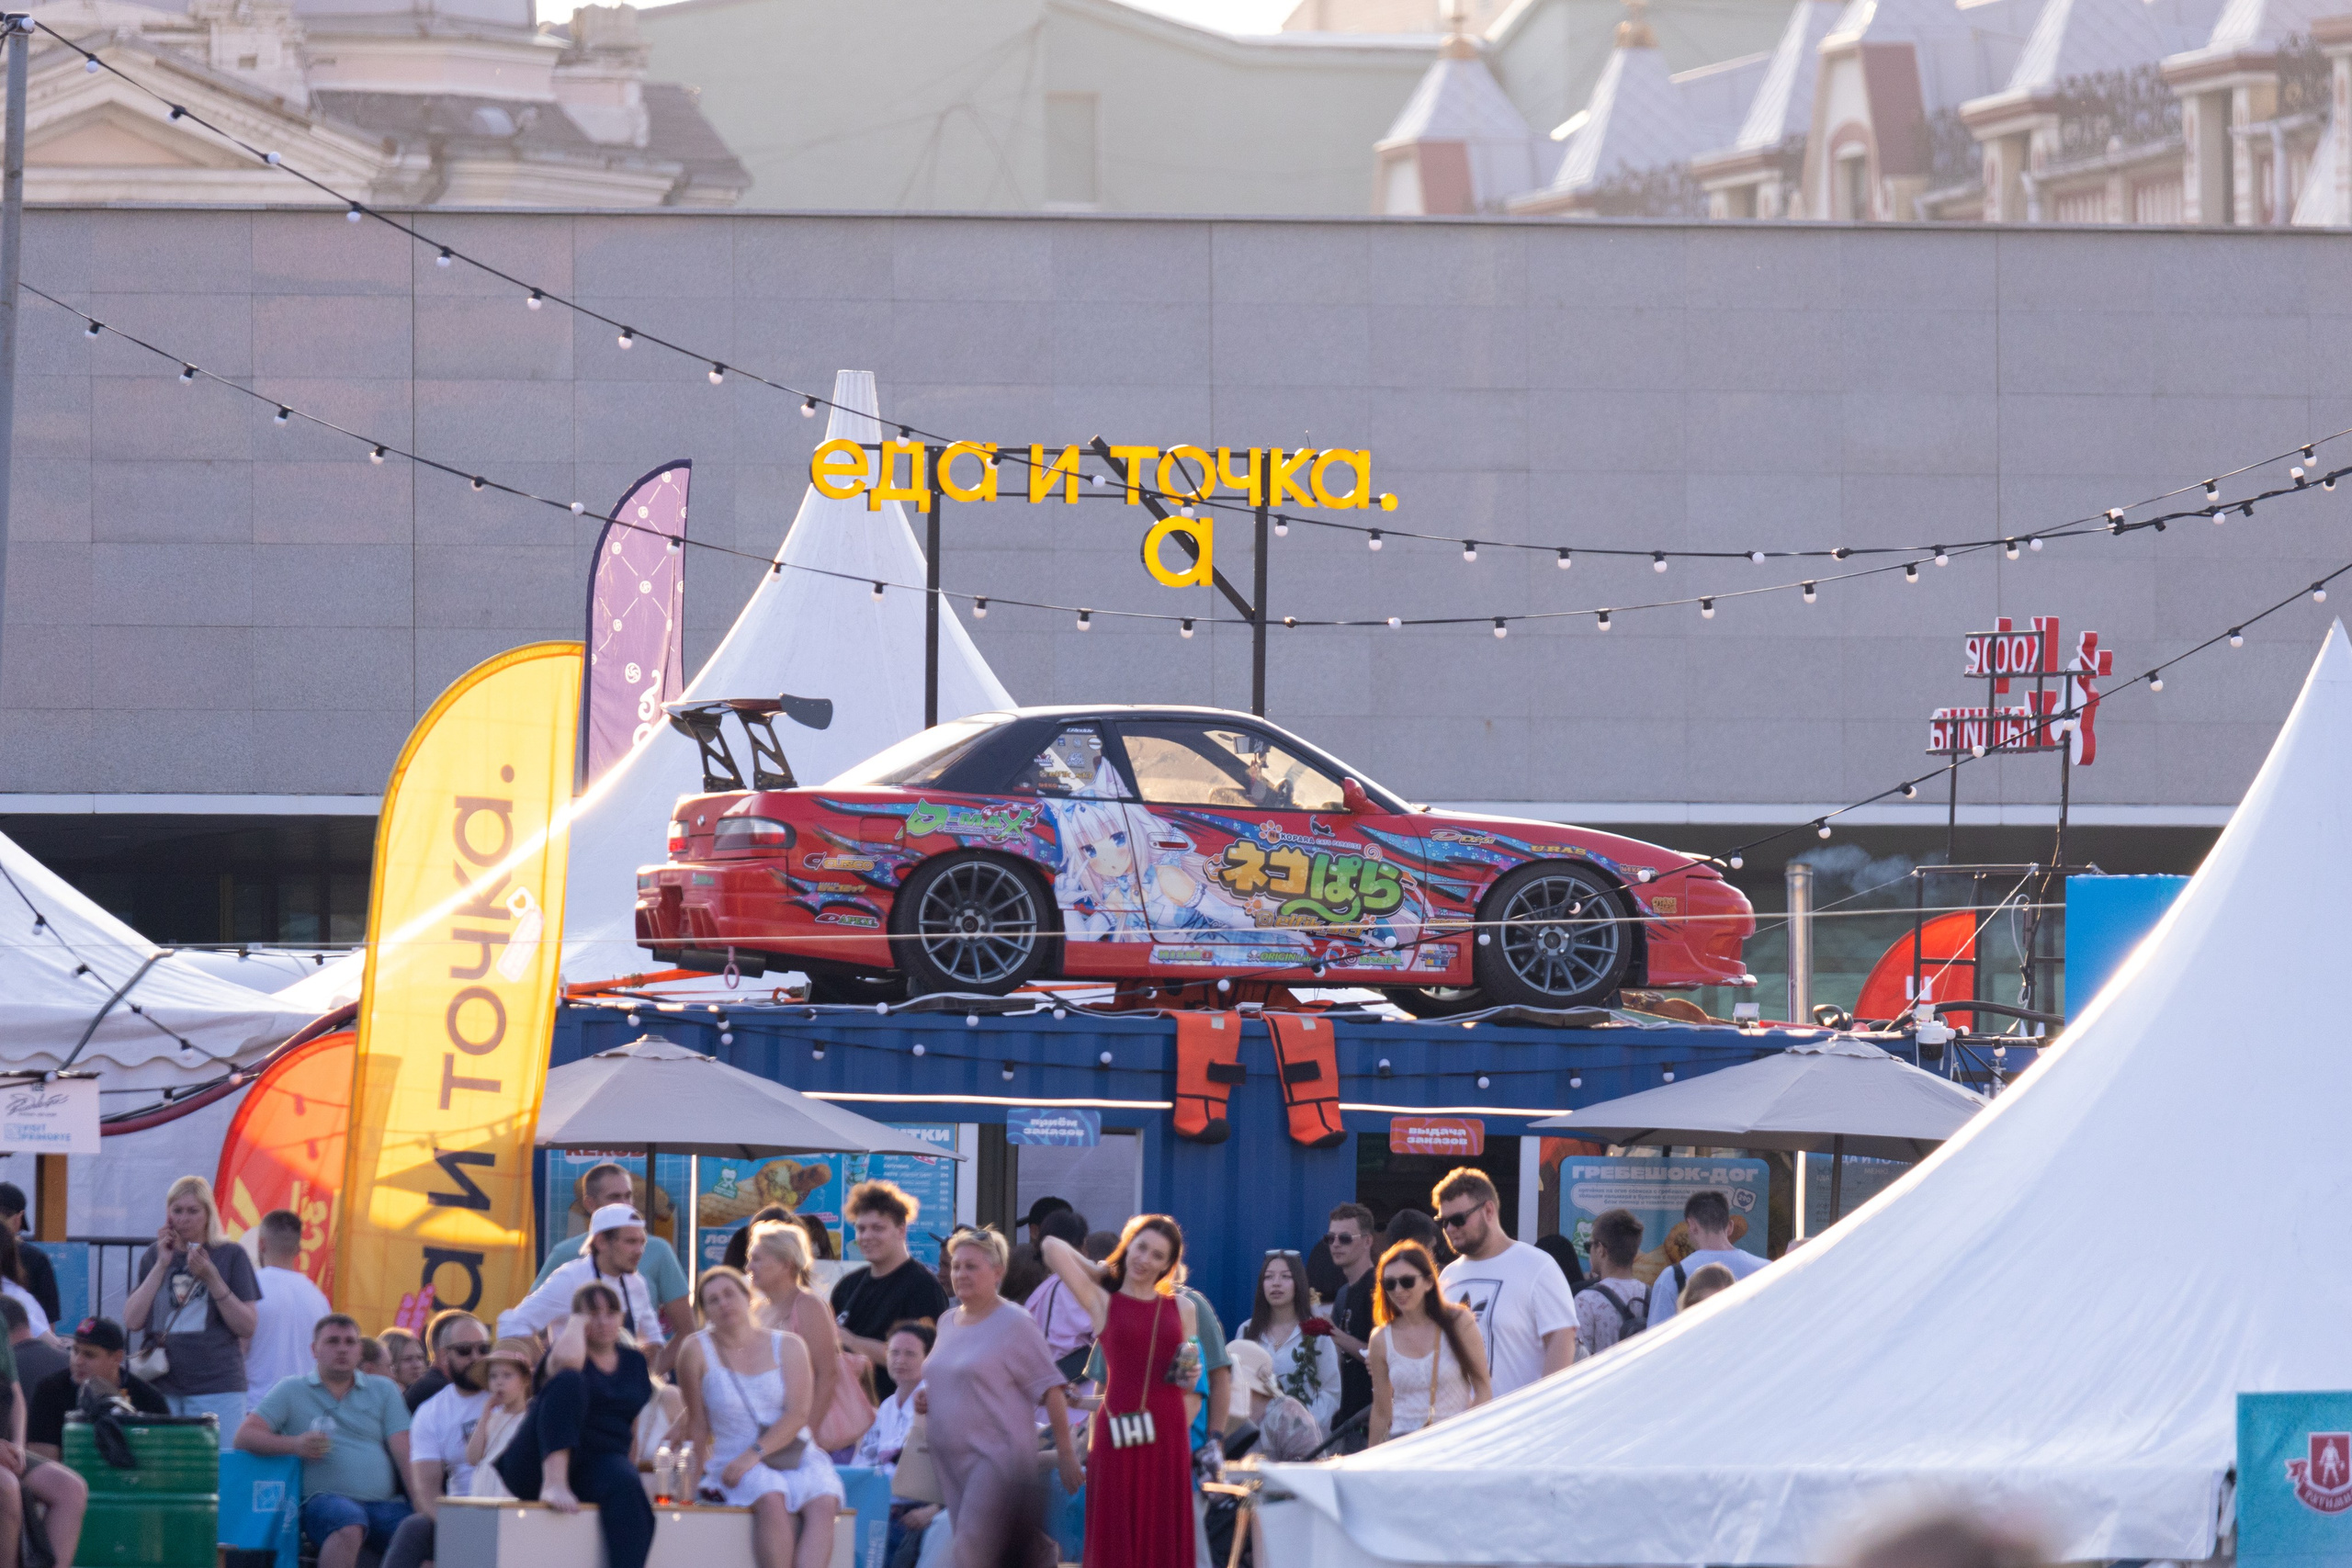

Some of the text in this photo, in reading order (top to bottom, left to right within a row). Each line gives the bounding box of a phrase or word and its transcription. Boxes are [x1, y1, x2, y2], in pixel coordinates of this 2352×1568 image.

[810, 437, 1399, 513] еда и точка.
[1270, 831, 1315, 844] NEKOPARA
[1531, 844, 1588, 856] URAS
[438, 763, 515, 1111] точка.
[1261, 952, 1297, 963] ORIGIN
[1030, 1117, 1078, 1127] приём
[1023, 1127, 1085, 1136] заказов
[1408, 1127, 1466, 1136] выдача
[1407, 1136, 1468, 1145] заказов
[426, 1148, 496, 1211] и
[1571, 1165, 1759, 1184] ГРЕБЕШОК-ДОГ
